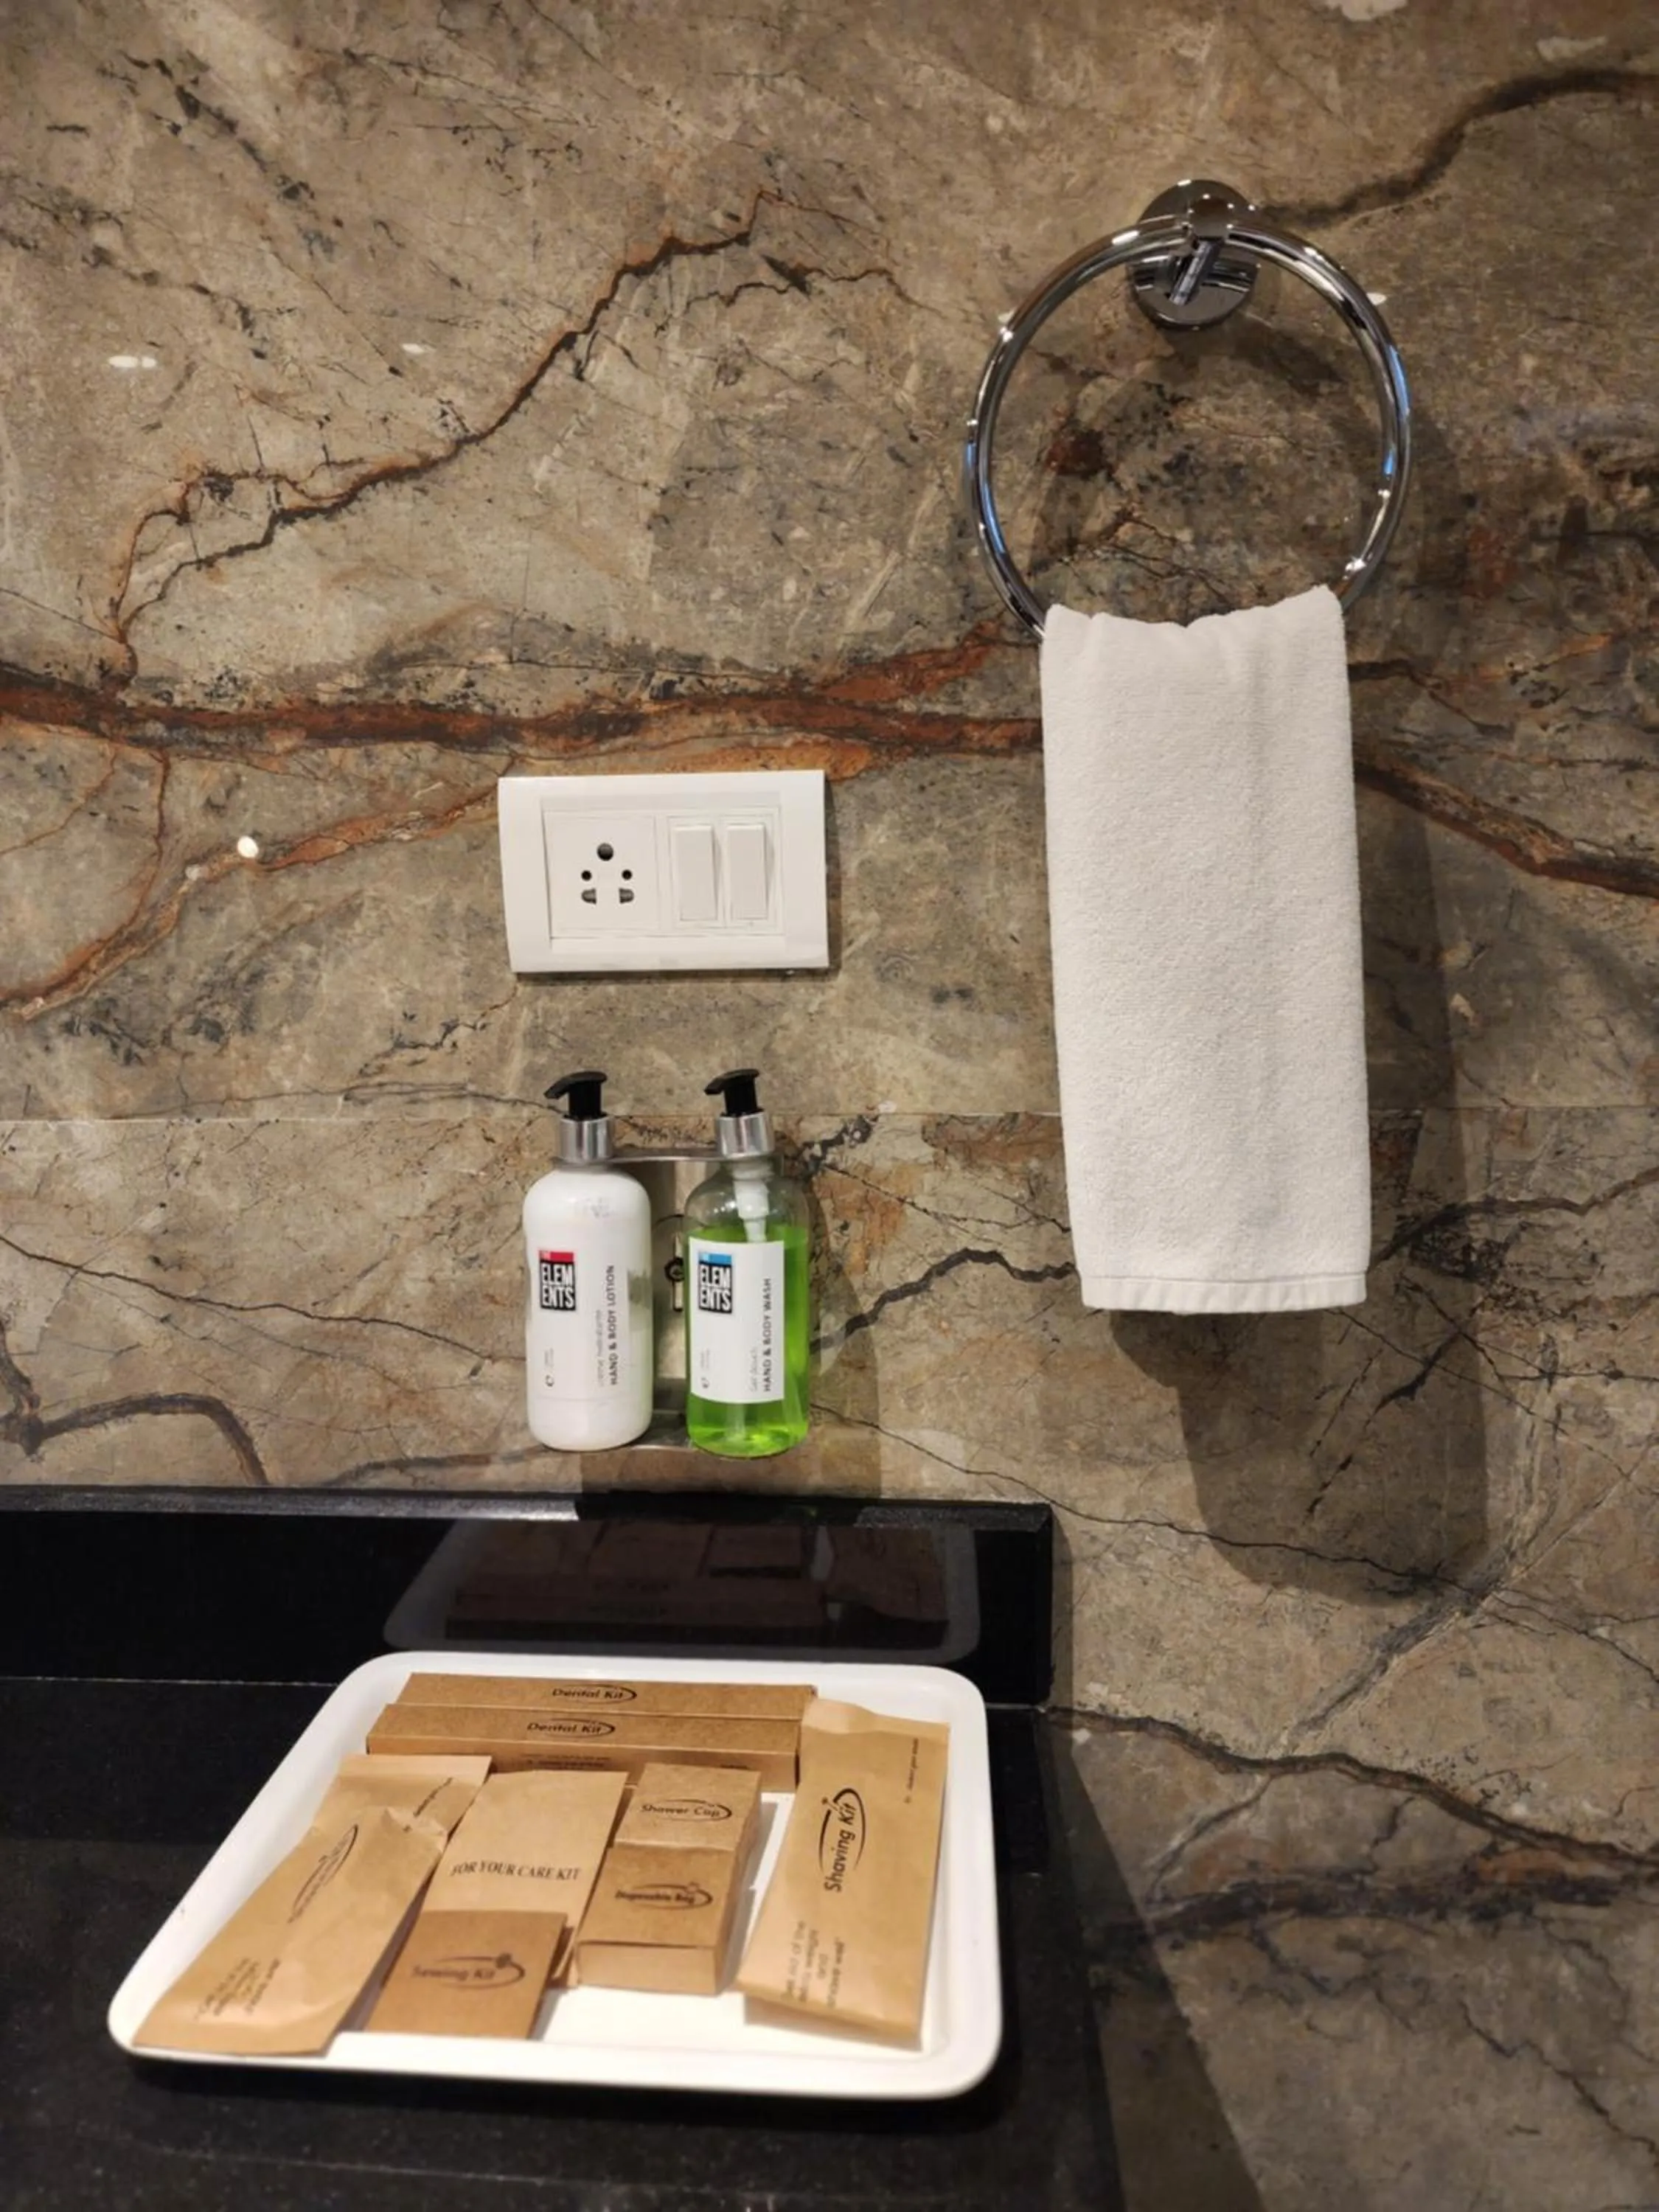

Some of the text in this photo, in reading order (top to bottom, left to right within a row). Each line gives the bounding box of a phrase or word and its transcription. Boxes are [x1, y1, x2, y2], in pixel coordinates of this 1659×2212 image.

[542, 1262, 574, 1286] ELEM
[700, 1264, 731, 1288] ELEM
[543, 1286, 575, 1310] ENTS
[700, 1287, 731, 1312] ENTS
[605, 1265, 619, 1386] HAND & BODY LOTION
[762, 1278, 772, 1392] HAND & BODY WASH
[552, 1687, 625, 1700] Dental Kit
[526, 1722, 602, 1733] Dental Kit
[641, 1804, 721, 1819] Shower Cap
[824, 1802, 858, 1893] Shaving Kit
[479, 1860, 517, 1875] YOUR
[516, 1864, 555, 1880] CARE
[555, 1867, 582, 1881] KIT
